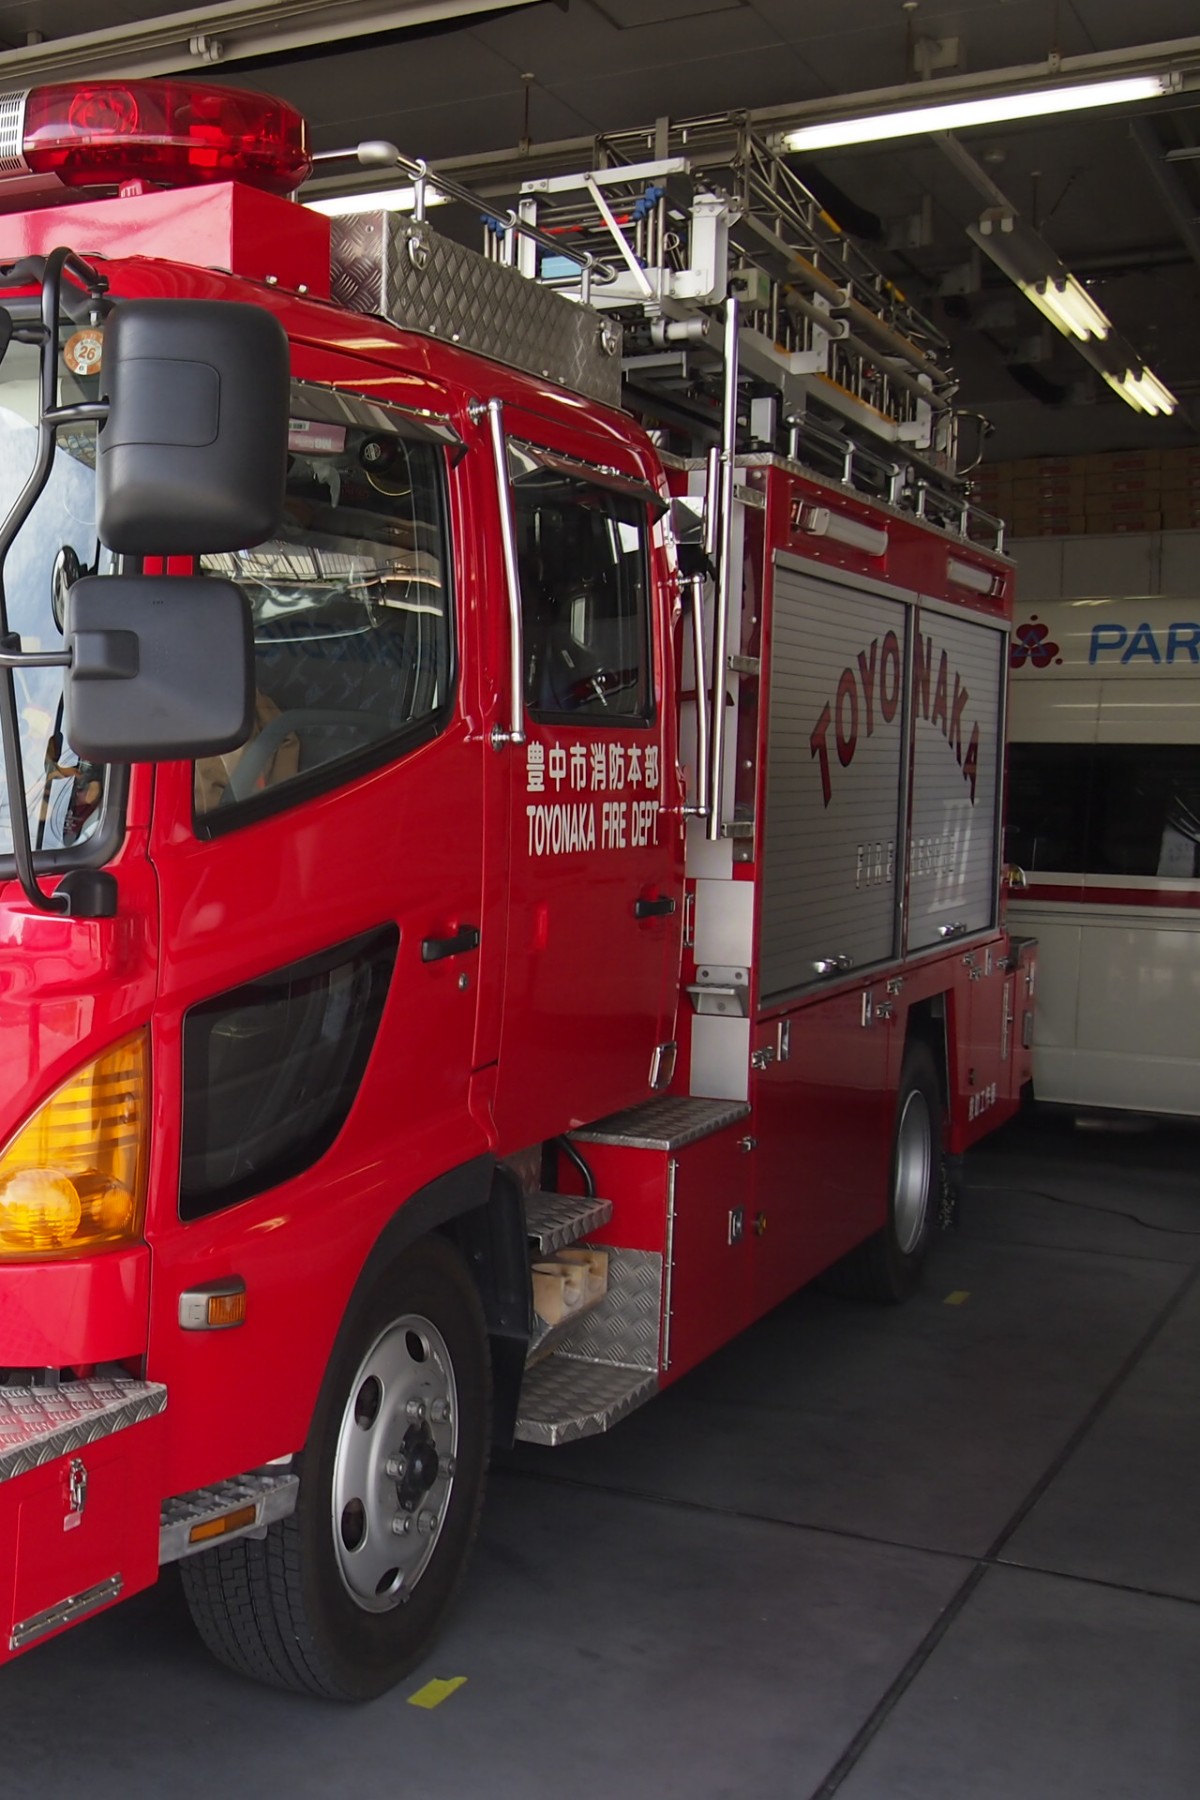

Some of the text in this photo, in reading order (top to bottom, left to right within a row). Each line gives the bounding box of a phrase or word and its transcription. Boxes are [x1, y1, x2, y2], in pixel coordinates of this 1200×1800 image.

[78, 345, 96, 360] 26
[526, 740, 659, 792] 豊中市消防本部
[526, 803, 596, 857] TOYONAKA
[601, 802, 627, 849] FIRE
